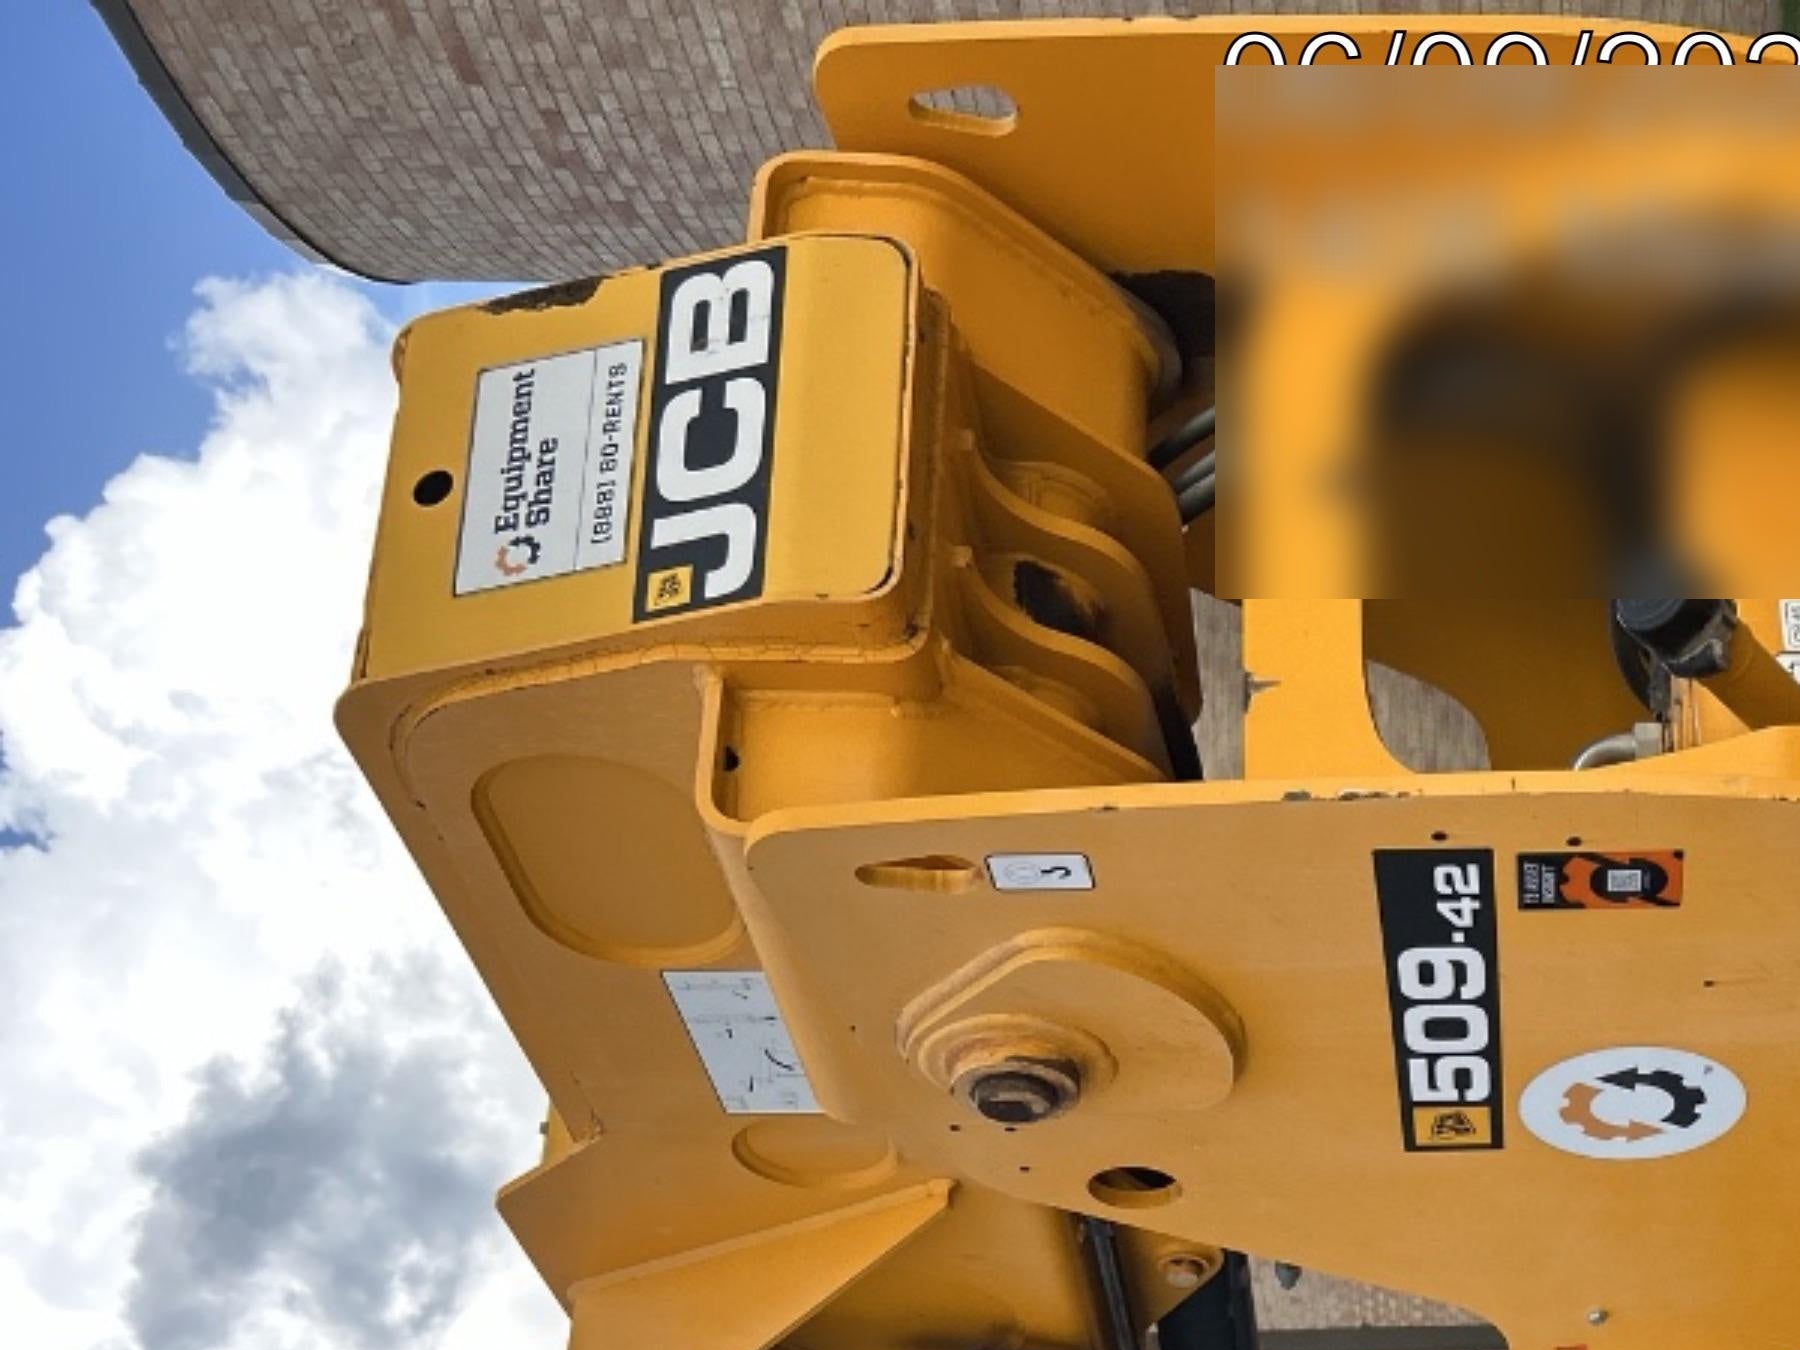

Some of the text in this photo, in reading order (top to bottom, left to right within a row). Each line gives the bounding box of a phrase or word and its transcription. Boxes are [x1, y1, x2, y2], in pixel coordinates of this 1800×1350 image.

[493, 368, 535, 535] Equipment
[524, 437, 559, 528] Share
[599, 362, 628, 472] 80-RENTS
[650, 259, 775, 598] JCB
